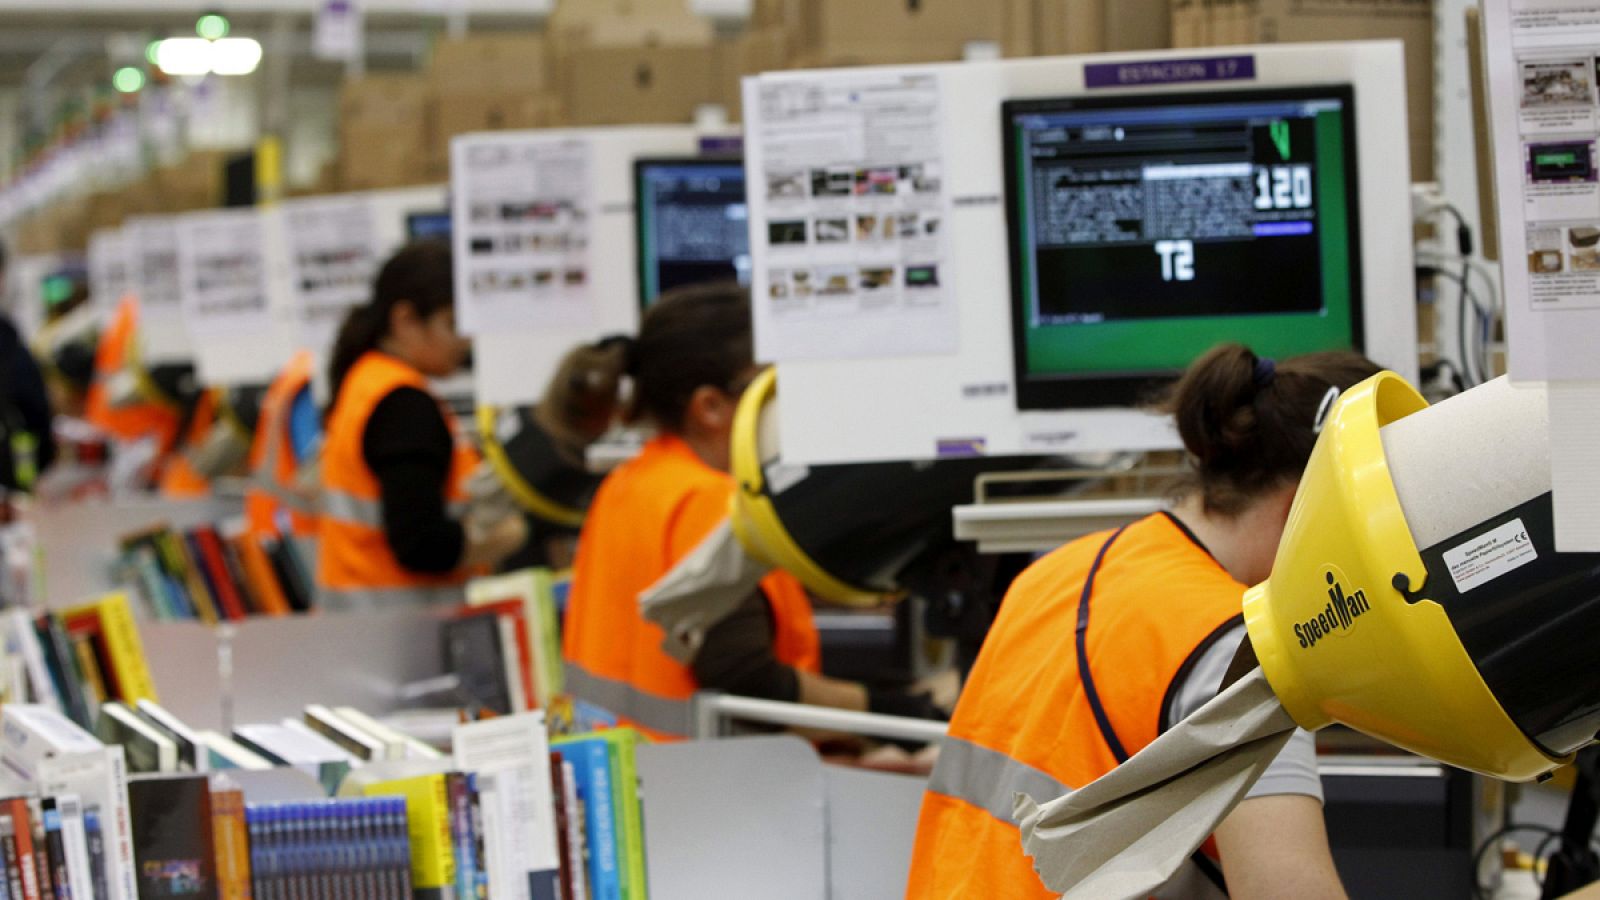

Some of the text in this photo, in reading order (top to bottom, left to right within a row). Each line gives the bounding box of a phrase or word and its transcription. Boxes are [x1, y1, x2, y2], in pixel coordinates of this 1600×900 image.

[1254, 167, 1312, 209] 120
[1155, 240, 1195, 281] T2
[1293, 571, 1371, 649] SpeedMan
